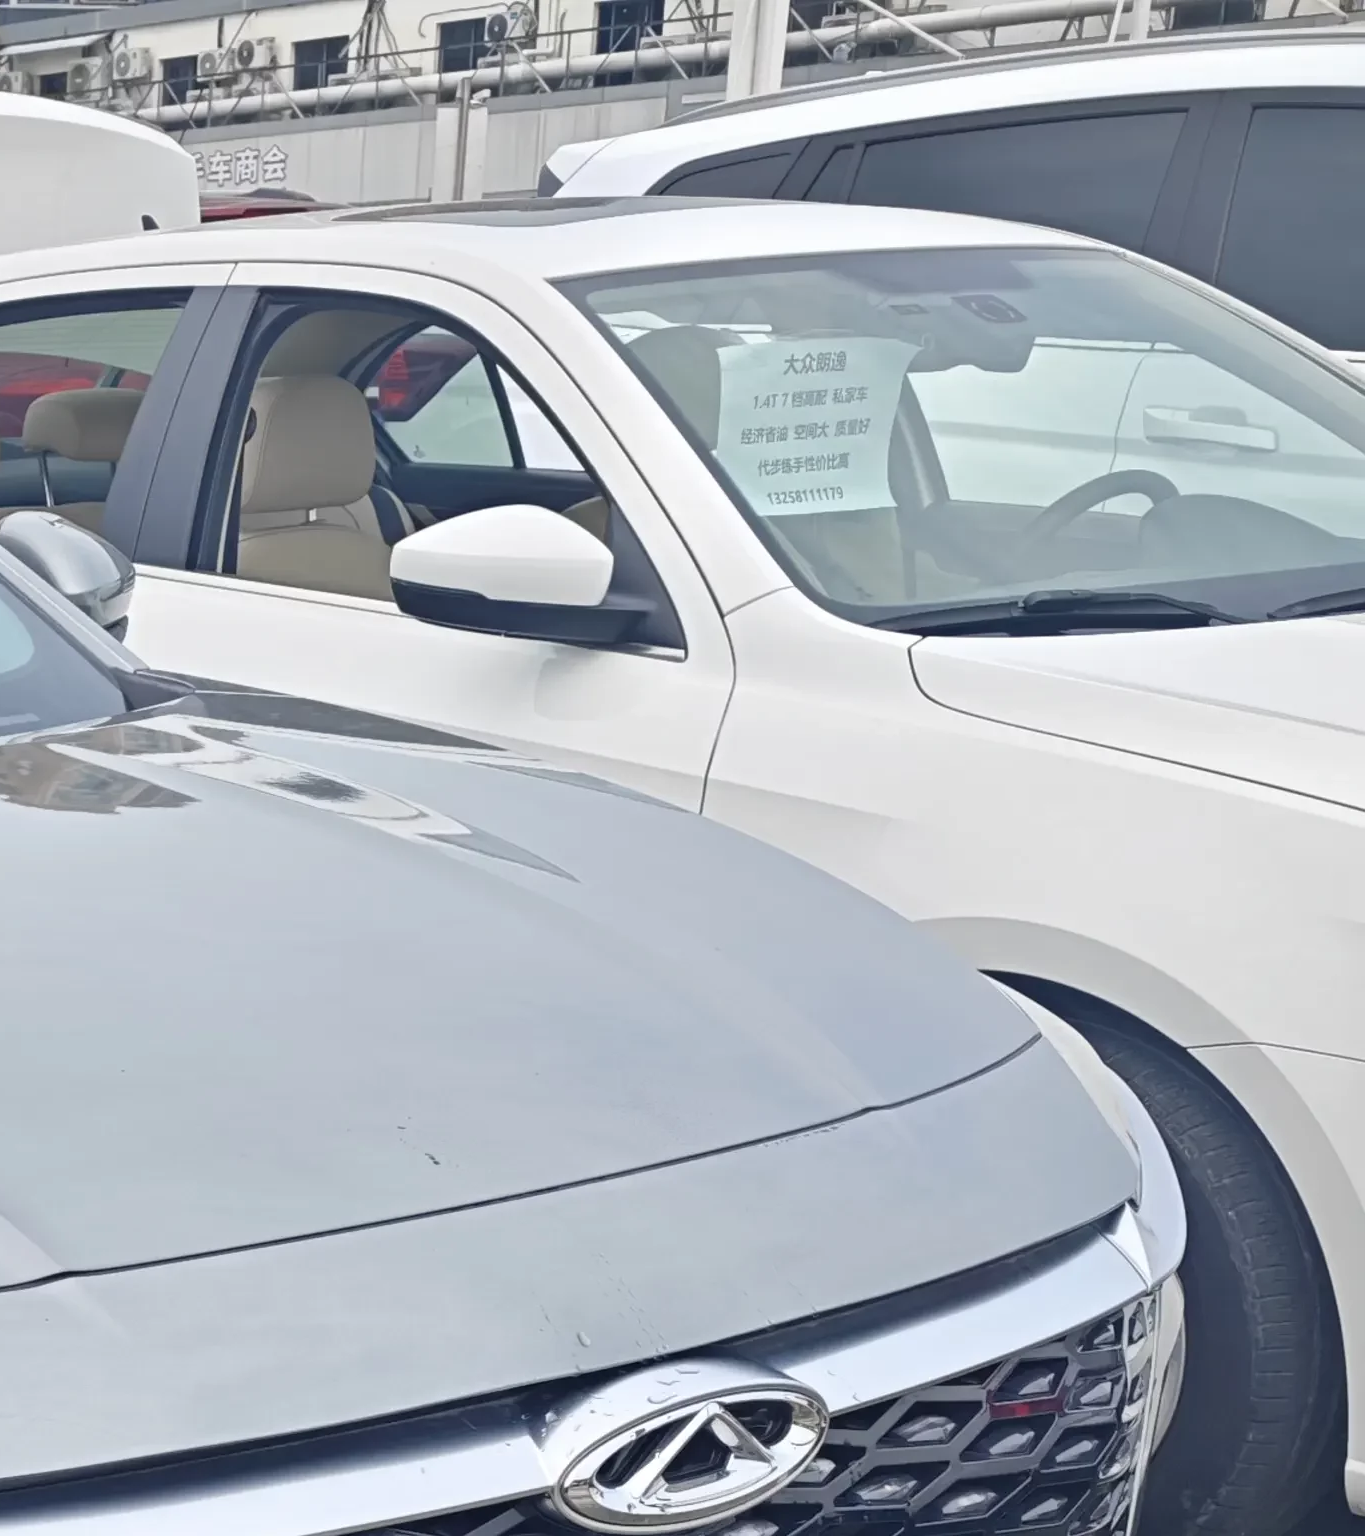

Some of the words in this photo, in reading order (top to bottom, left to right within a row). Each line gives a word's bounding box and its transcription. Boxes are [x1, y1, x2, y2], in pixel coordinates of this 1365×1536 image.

[783, 351, 847, 375] 大众朗逸
[832, 387, 869, 404] 私家车
[740, 426, 789, 445] 经济省油
[793, 422, 829, 440] 空间大
[834, 418, 871, 437] 质量好
[767, 486, 844, 505] 13258111179
